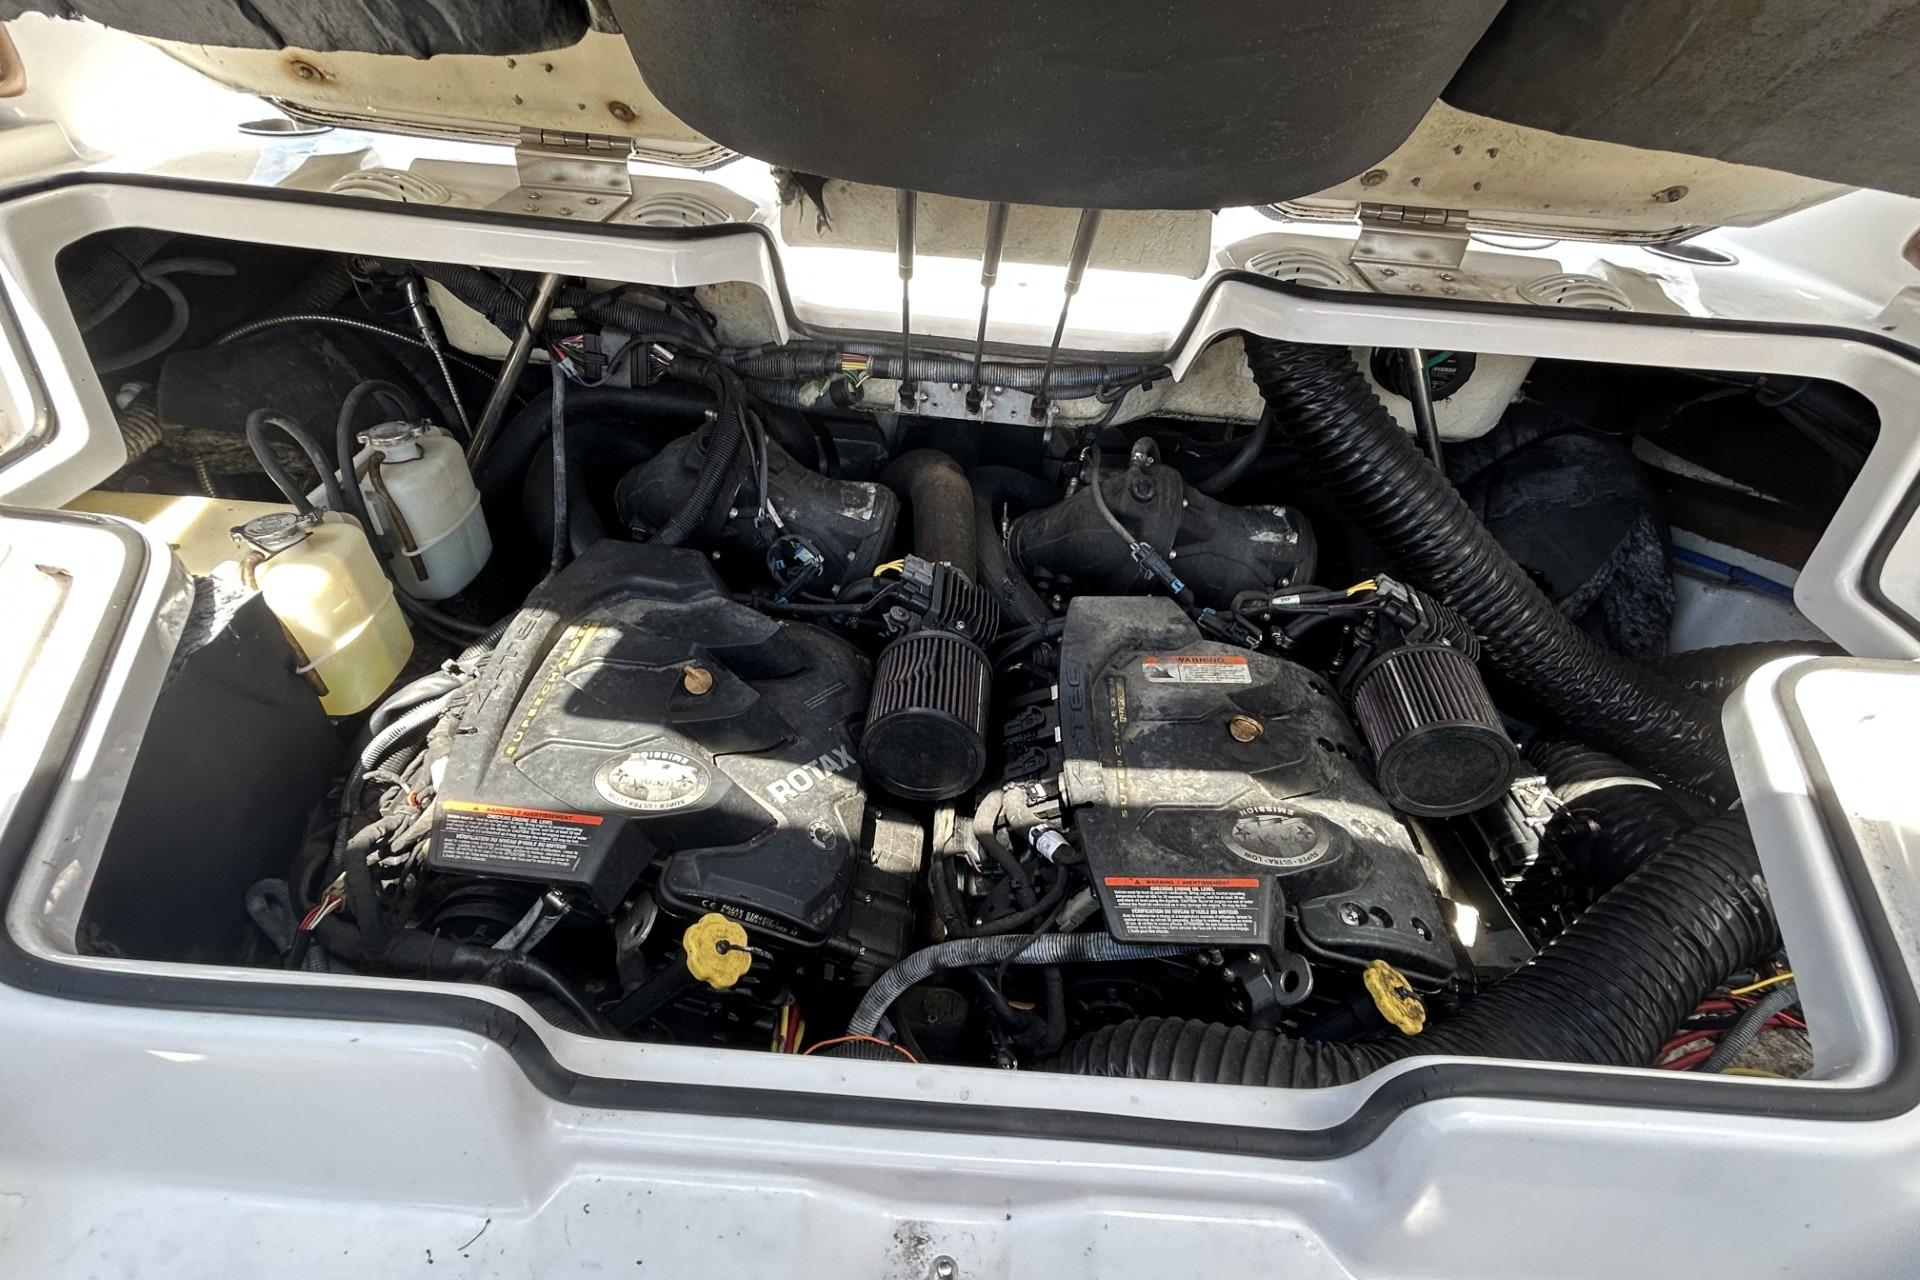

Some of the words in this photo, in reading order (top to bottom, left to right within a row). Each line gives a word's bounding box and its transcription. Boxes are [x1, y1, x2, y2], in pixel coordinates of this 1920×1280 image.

[1108, 677, 1127, 818] SUPERCHARGED
[766, 744, 857, 804] ROTAX
[628, 800, 653, 808] ULTRA
[659, 799, 686, 809] SUPER
[1239, 806, 1295, 816] EMISSION
[1243, 852, 1263, 862] LOW
[1297, 851, 1319, 864] SUPER
